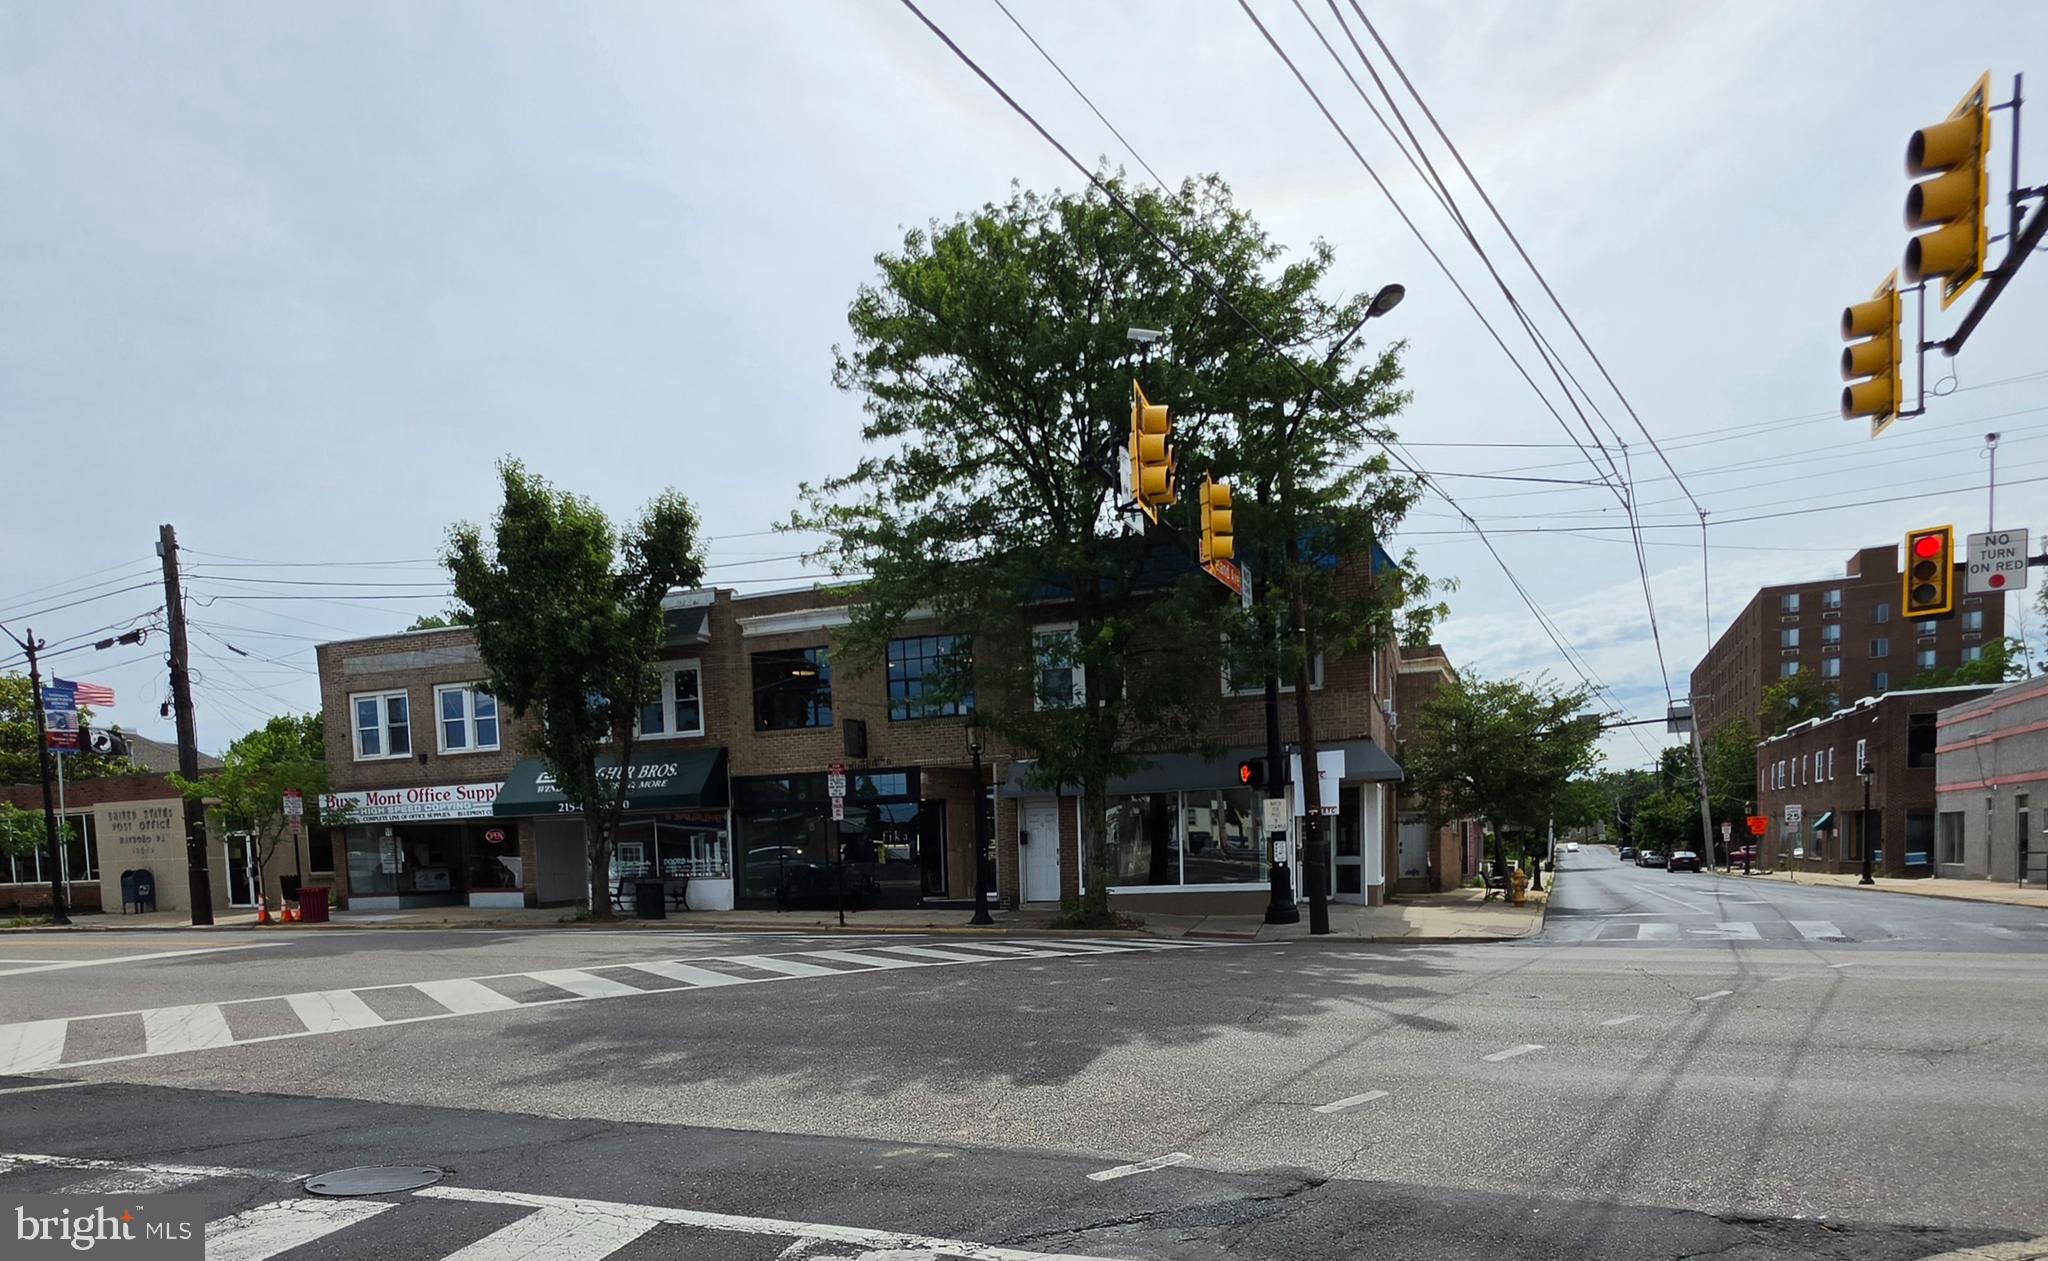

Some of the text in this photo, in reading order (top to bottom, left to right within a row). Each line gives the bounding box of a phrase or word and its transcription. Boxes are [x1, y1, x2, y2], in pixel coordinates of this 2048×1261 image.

[1985, 534, 2009, 547] NO
[1980, 548, 2015, 560] TURN
[1970, 560, 2024, 574] ON RED
[637, 763, 678, 779] BROS.
[638, 779, 669, 789] MORE
[366, 791, 402, 806] Mont
[407, 787, 451, 803] Office
[360, 802, 472, 815] HIGH SPEED COPYING
[1787, 813, 1800, 821] 25
[139, 818, 170, 831] OFFICE
